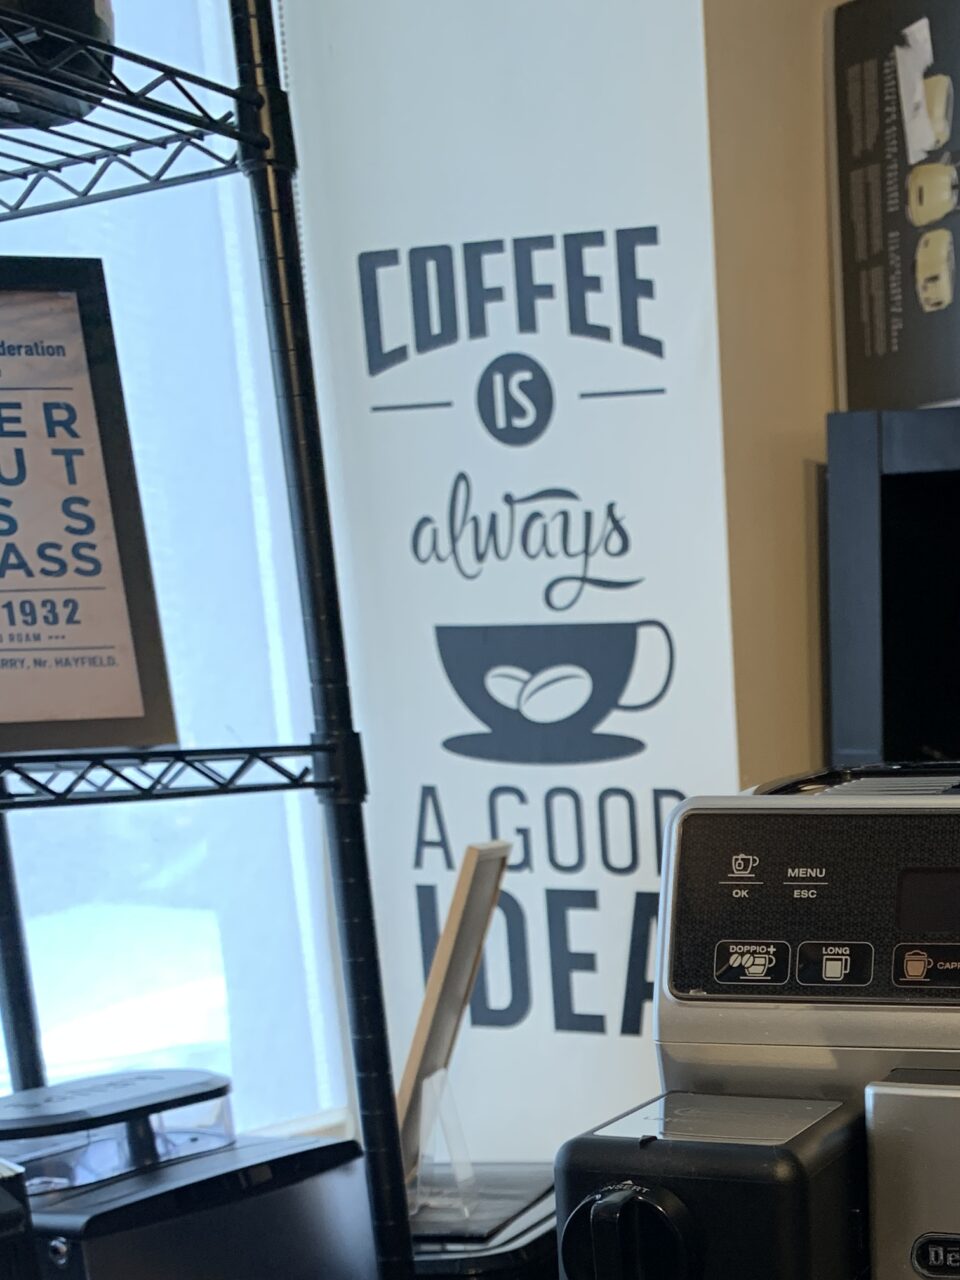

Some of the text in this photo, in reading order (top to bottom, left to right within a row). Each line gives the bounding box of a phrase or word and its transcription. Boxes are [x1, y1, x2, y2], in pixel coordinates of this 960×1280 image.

[358, 226, 665, 377] COFFEE
[491, 370, 538, 430] IS
[411, 471, 645, 612] always
[1, 598, 82, 627] 1932
[413, 784, 456, 871] A
[787, 867, 826, 879] MENU
[732, 888, 750, 899] OK
[793, 888, 818, 899] ESC
[822, 946, 850, 955] LONG
